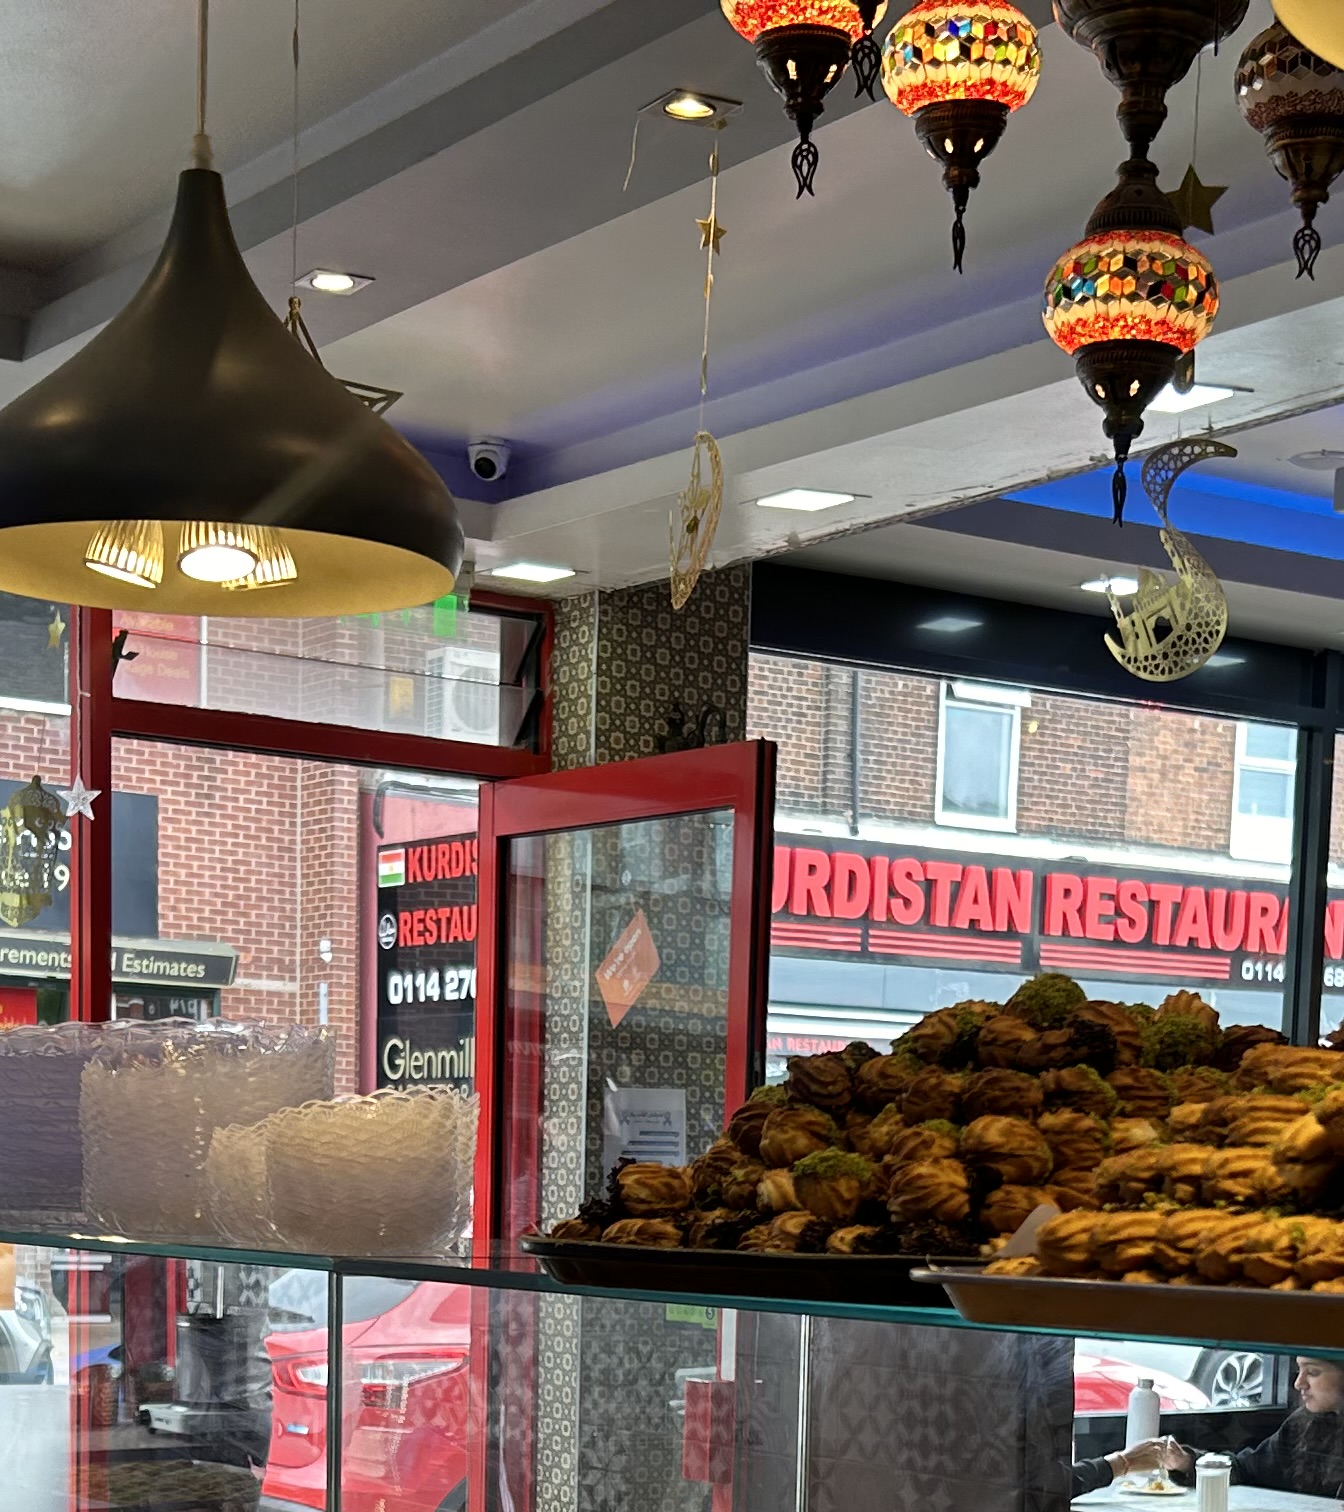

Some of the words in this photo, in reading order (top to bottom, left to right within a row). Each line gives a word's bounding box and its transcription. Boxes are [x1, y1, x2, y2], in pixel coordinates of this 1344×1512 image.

[398, 904, 477, 948] RESTAU
[122, 955, 206, 979] Estimates
[1242, 961, 1285, 983] 0114
[388, 971, 440, 1005] 0114
[383, 1037, 475, 1080] Glenmill
